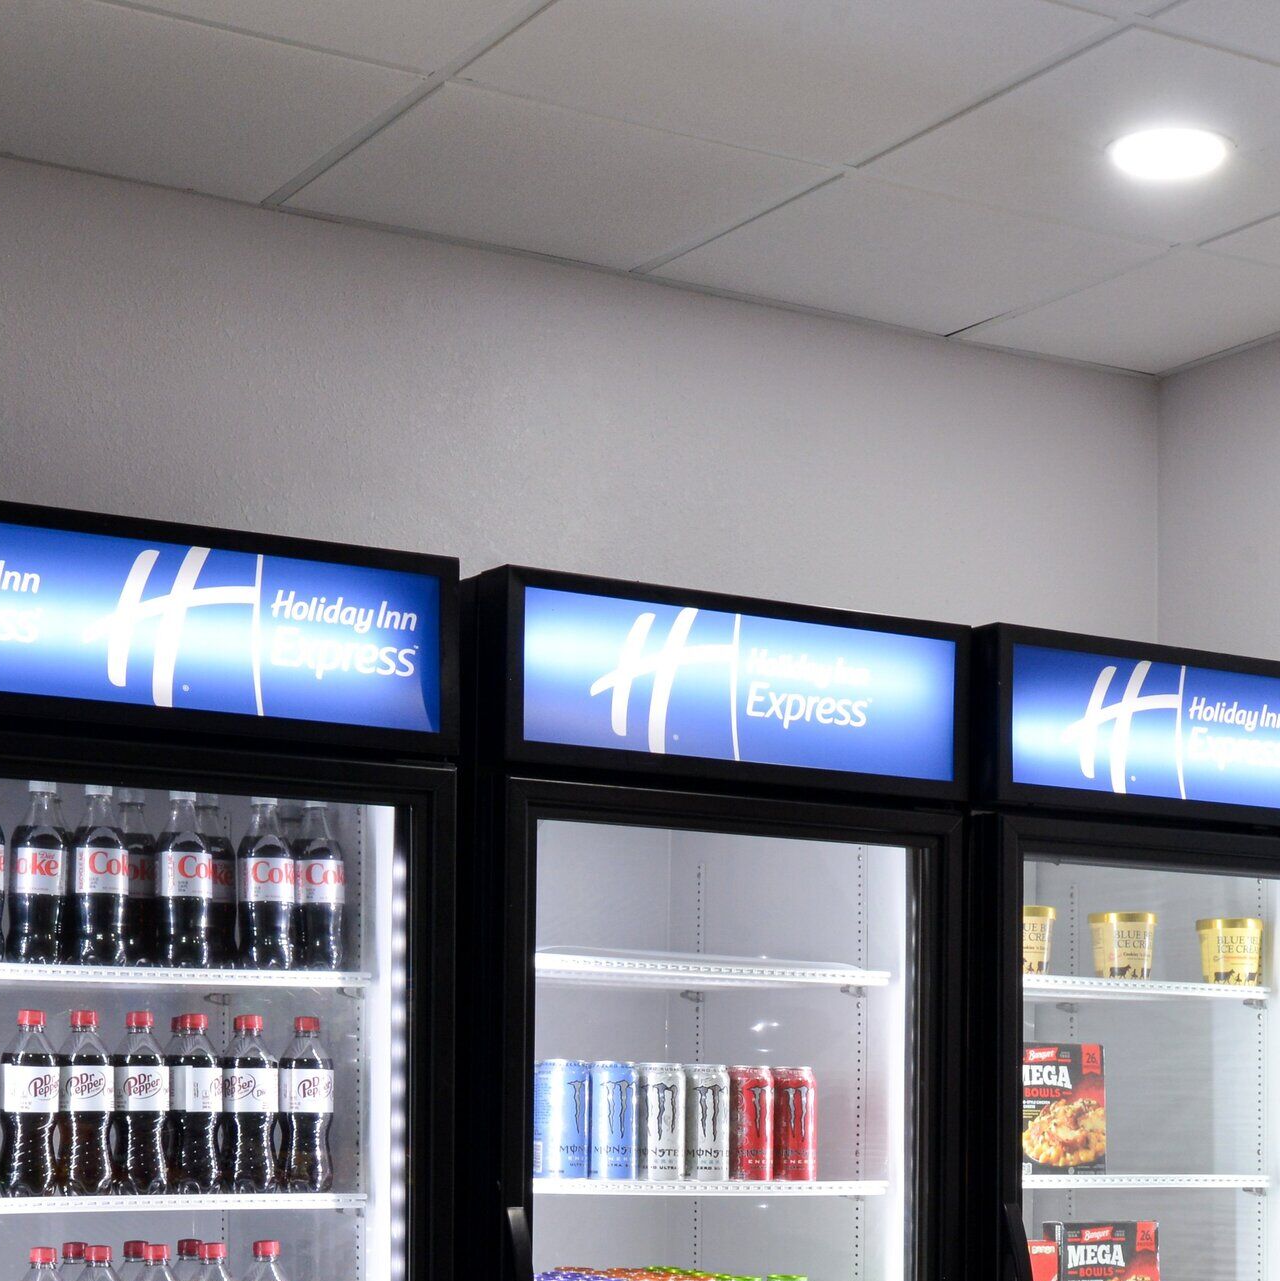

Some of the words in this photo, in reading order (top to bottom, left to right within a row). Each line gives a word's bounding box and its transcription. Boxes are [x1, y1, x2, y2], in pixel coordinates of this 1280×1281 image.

[271, 590, 374, 633] Holiday
[377, 601, 417, 631] Inn
[271, 627, 415, 679] Express
[747, 648, 834, 687] Holiday
[835, 657, 870, 686] Inn
[747, 682, 867, 729] Express
[1189, 697, 1258, 732] Holiday
[89, 851, 128, 875] Cok
[1115, 930, 1140, 939] BLUE
[1217, 936, 1245, 944] BLUE
[1217, 945, 1234, 953] ICE
[80, 1073, 95, 1083] Dr
[126, 1077, 160, 1097] Pepper
[138, 1074, 152, 1085] Dr
[1025, 1088, 1060, 1097] BOWLS
[1067, 1244, 1125, 1269] MEGA
[1079, 1268, 1114, 1277] BOWLS
